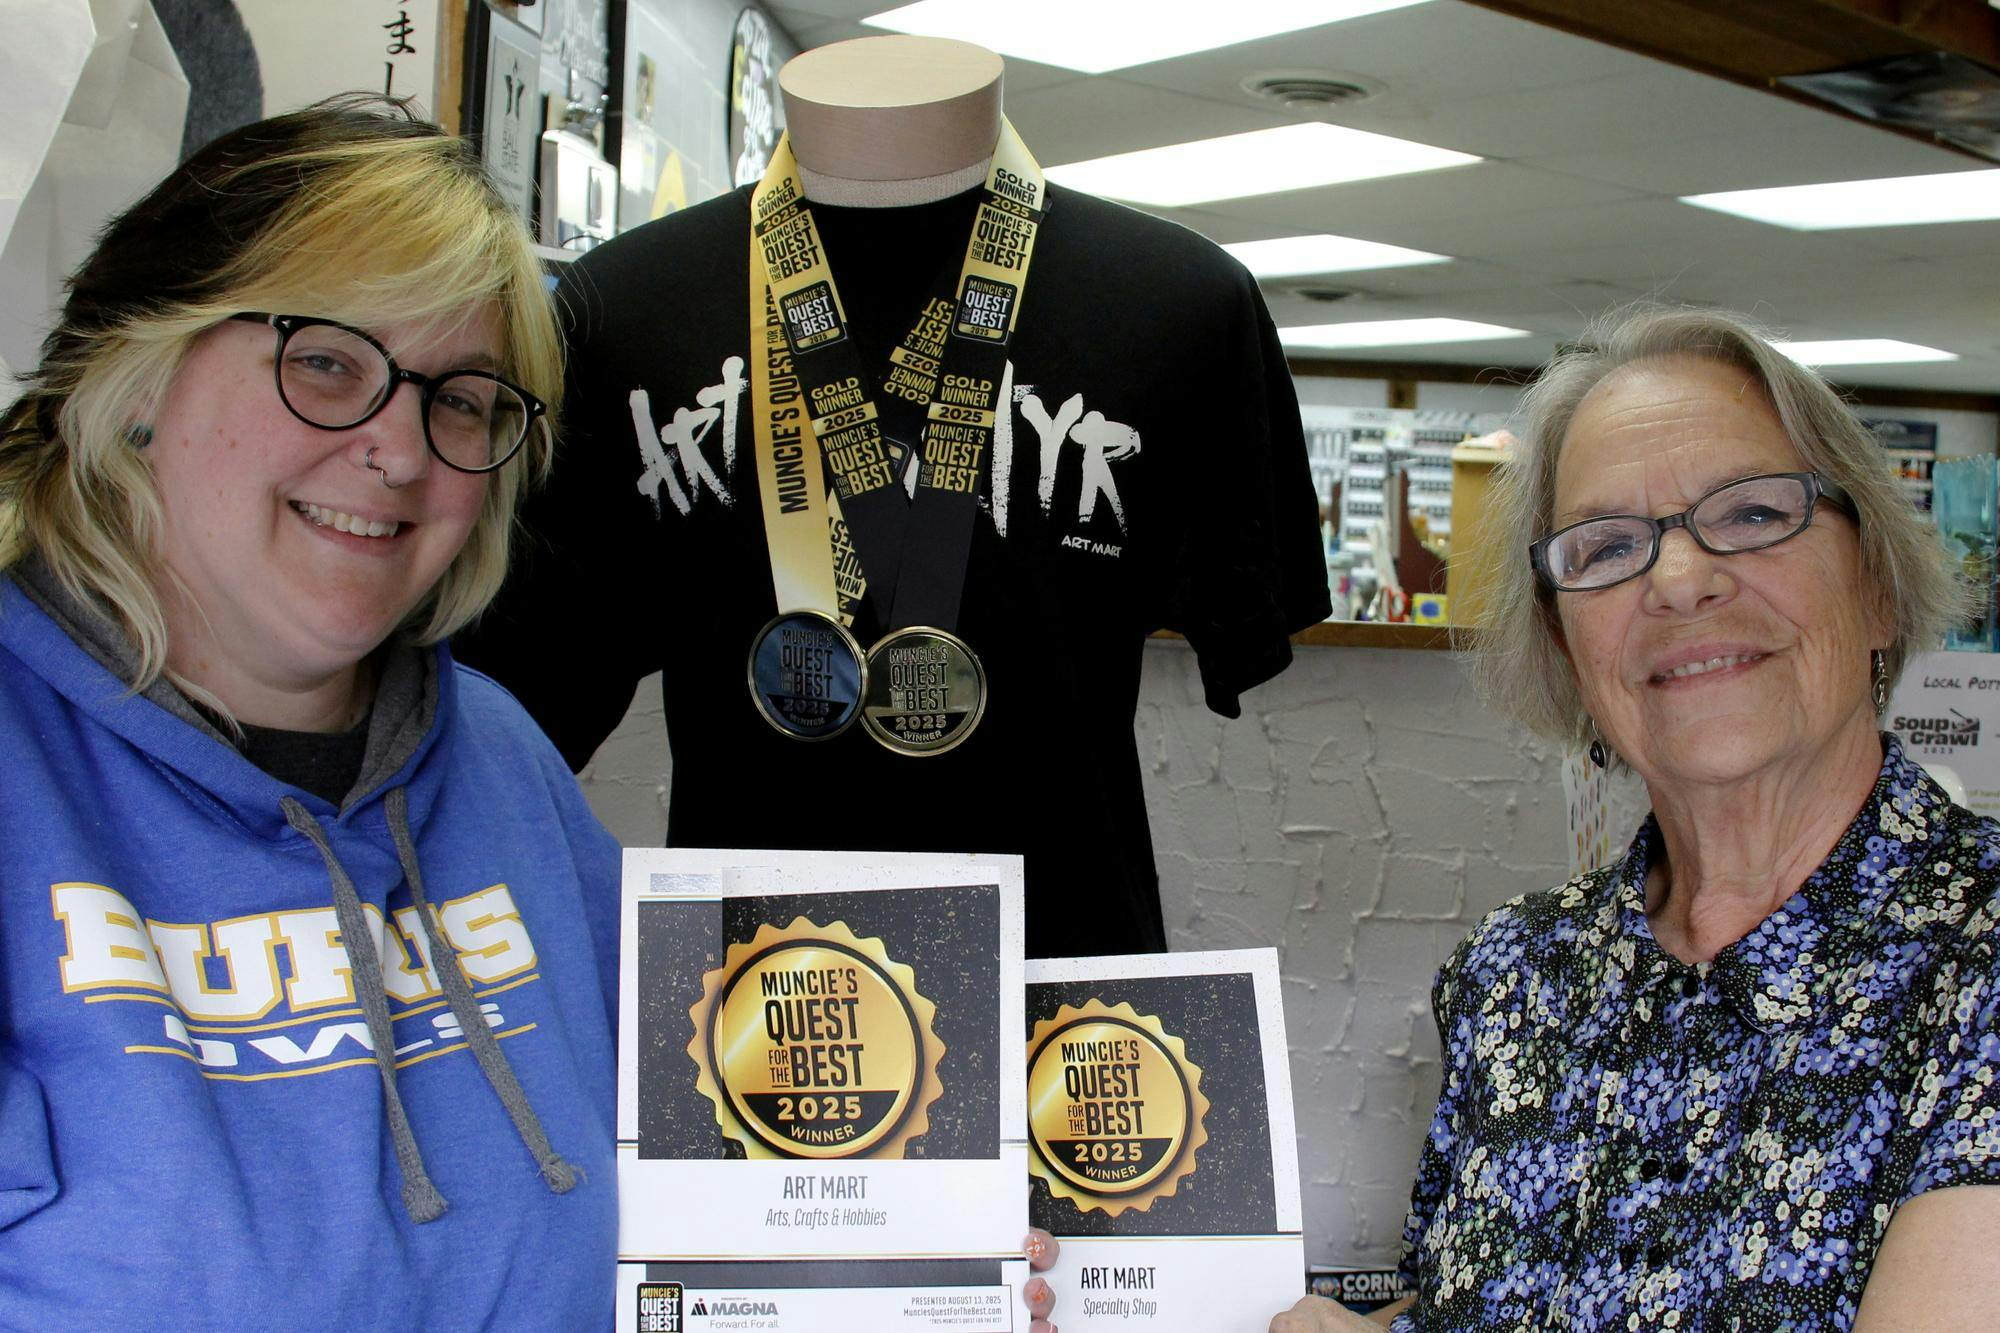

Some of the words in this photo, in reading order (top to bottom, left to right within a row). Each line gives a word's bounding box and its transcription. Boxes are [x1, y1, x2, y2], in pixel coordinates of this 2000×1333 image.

[757, 177, 792, 207] GOLD
[994, 177, 1035, 206] WINNER
[996, 167, 1037, 193] GOLD
[758, 187, 796, 218] WINNER
[990, 195, 1030, 218] 2025
[763, 204, 798, 232] 2025
[981, 207, 1033, 235] MUNCIE'S
[761, 214, 809, 248] MUNCIE'S
[977, 220, 1030, 252] QUEST
[765, 226, 813, 264] QUEST
[973, 240, 985, 250] FOR
[780, 245, 819, 279] BEST
[971, 249, 983, 259] THE
[983, 246, 1026, 271] BEST
[784, 286, 827, 309] MUNCIE'S
[968, 280, 1013, 298] MUNCIE'S
[787, 295, 831, 324] QUEST
[921, 297, 954, 324] EST
[965, 290, 1010, 314] QUEST
[801, 312, 836, 337] BEST
[911, 317, 948, 345] EST
[970, 308, 1006, 330] BEST
[970, 326, 989, 336] 2025
[767, 329, 778, 344] FOR
[904, 334, 943, 358] NCIE'S
[767, 347, 800, 401] QUEST
[889, 366, 937, 395] WINNER
[943, 374, 993, 392] GOLD
[811, 377, 859, 399] GOLD
[883, 381, 930, 405] GOLD
[941, 386, 989, 407] WINNER
[814, 388, 864, 415] WINNER
[823, 407, 866, 431] 2025
[938, 406, 984, 423] 2025
[822, 422, 879, 453] MUNCIE'S
[928, 423, 986, 445] MUNCIE'S
[770, 407, 809, 514] MUNCIE'S
[828, 437, 885, 476] QUEST
[925, 438, 983, 468] QUEST
[835, 475, 848, 486] FOR
[839, 484, 852, 496] THE
[847, 460, 893, 495] BEST
[920, 474, 932, 484] THE
[932, 464, 978, 493] BEST
[921, 464, 934, 474] FOR
[1061, 534, 1091, 551] ART
[1091, 542, 1122, 558] MART
[781, 645, 833, 673] QUEST
[889, 646, 948, 663] MUNCIE'S
[793, 672, 833, 699] BEST
[890, 662, 948, 688] QUEST
[1923, 676, 1961, 688] LOCAL
[906, 687, 949, 711] BEST
[895, 715, 947, 730] 2025
[1893, 716, 1949, 732] Soup
[903, 730, 942, 742] WINNER
[1910, 731, 1979, 746] Crawl
[760, 968, 858, 997] MUNCIE'S
[764, 997, 860, 1047] QUEST
[768, 1049, 789, 1065] FOR
[1061, 1040, 1140, 1063] MUNCIE'S
[770, 1067, 790, 1083] THE
[789, 1043, 864, 1088] BEST
[1065, 1063, 1140, 1102] QUEST
[776, 1096, 862, 1121] 2025
[1067, 1104, 1084, 1118] FOR
[1068, 1119, 1085, 1132] THE
[1085, 1100, 1144, 1136] BEST
[791, 1124, 856, 1143] WINNER
[1074, 1142, 1143, 1162] 2025
[1085, 1165, 1137, 1180] WINNER
[783, 1176, 816, 1199] ART
[820, 1176, 868, 1199] MART
[765, 1208, 791, 1227] Arts,
[794, 1207, 829, 1230] Crafts
[831, 1208, 839, 1226] &
[842, 1208, 887, 1226] Hobbies
[1081, 1267, 1109, 1289] ART
[1113, 1267, 1156, 1289] MART
[640, 1288, 679, 1298] MUNCIE'S
[911, 1296, 947, 1306] PRESENTED
[948, 1296, 972, 1305] AUGUST
[985, 1295, 1002, 1304] 2025
[1343, 1291, 1390, 1301] ROLLER
[640, 1297, 679, 1315] QUEST
[711, 1303, 778, 1316] MAGNA
[904, 1307, 1002, 1317] MunciesQuestForTheBest.com
[1083, 1297, 1130, 1318] Specialty
[1132, 1297, 1157, 1318] Shop
[649, 1315, 679, 1331] BEST
[710, 1320, 749, 1328] Forward.
[751, 1320, 765, 1328] For
